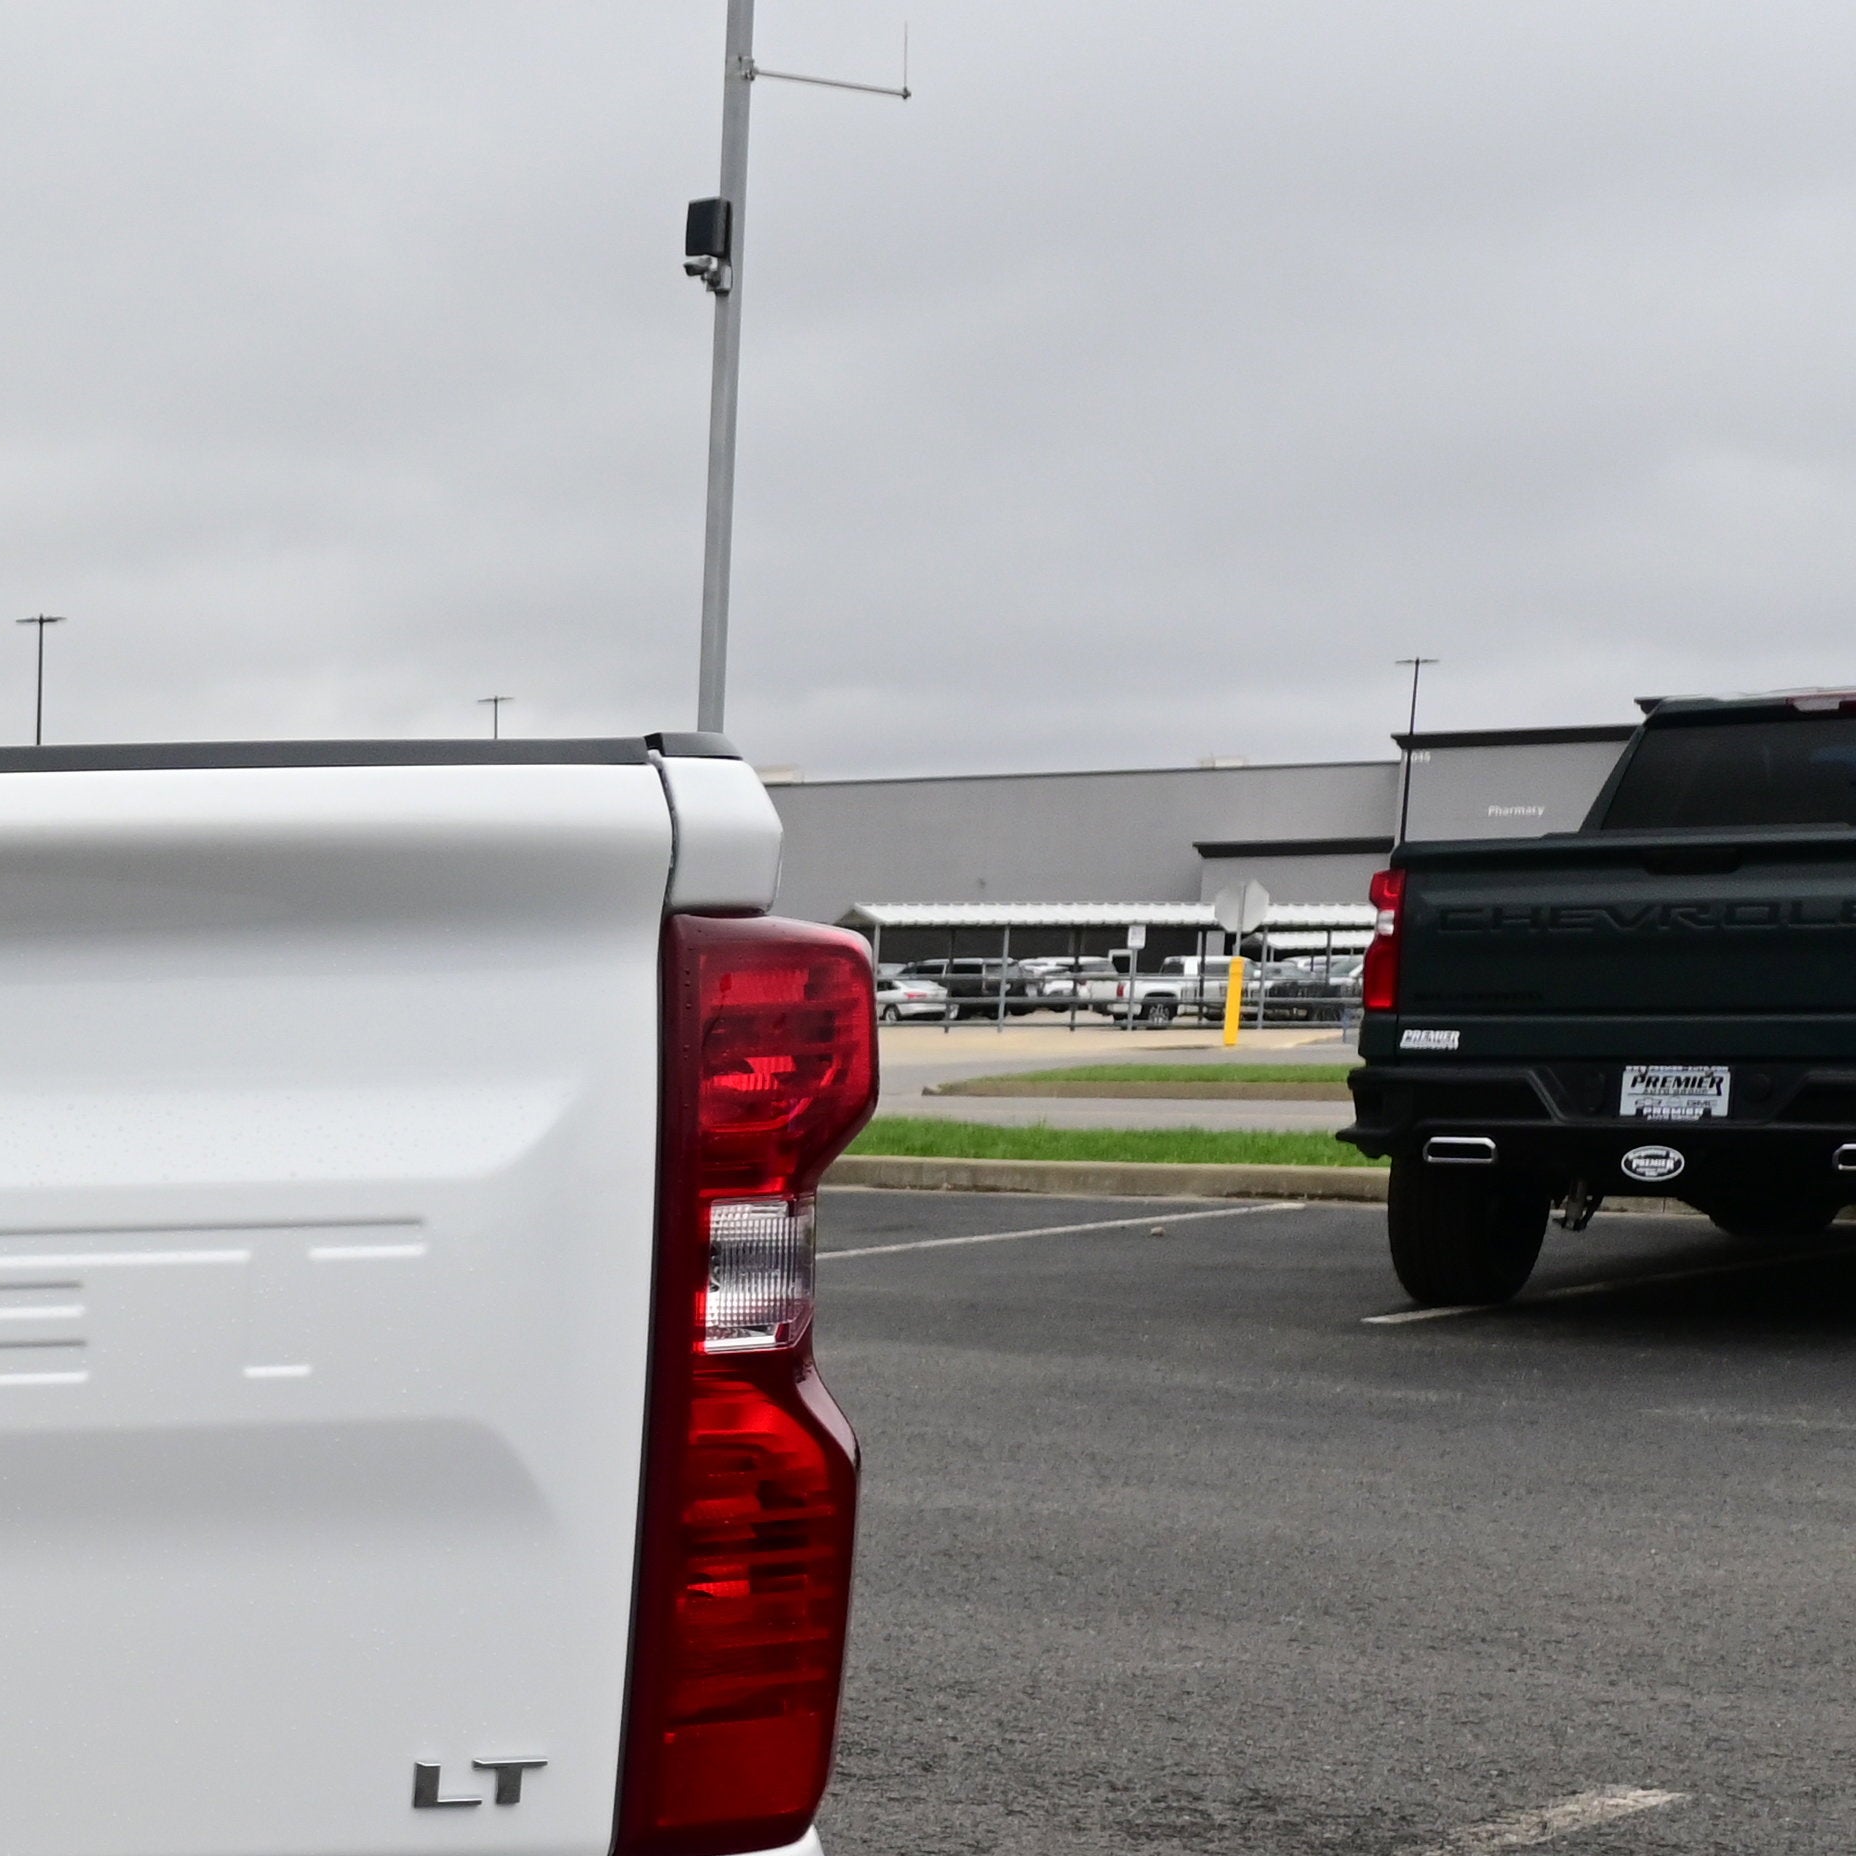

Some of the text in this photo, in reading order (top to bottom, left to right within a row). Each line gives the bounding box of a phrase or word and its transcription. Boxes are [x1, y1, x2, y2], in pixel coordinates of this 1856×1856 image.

[1488, 805, 1545, 817] Pharmacy
[1630, 1075, 1724, 1094] PREMIER
[413, 1757, 548, 1808] LT
